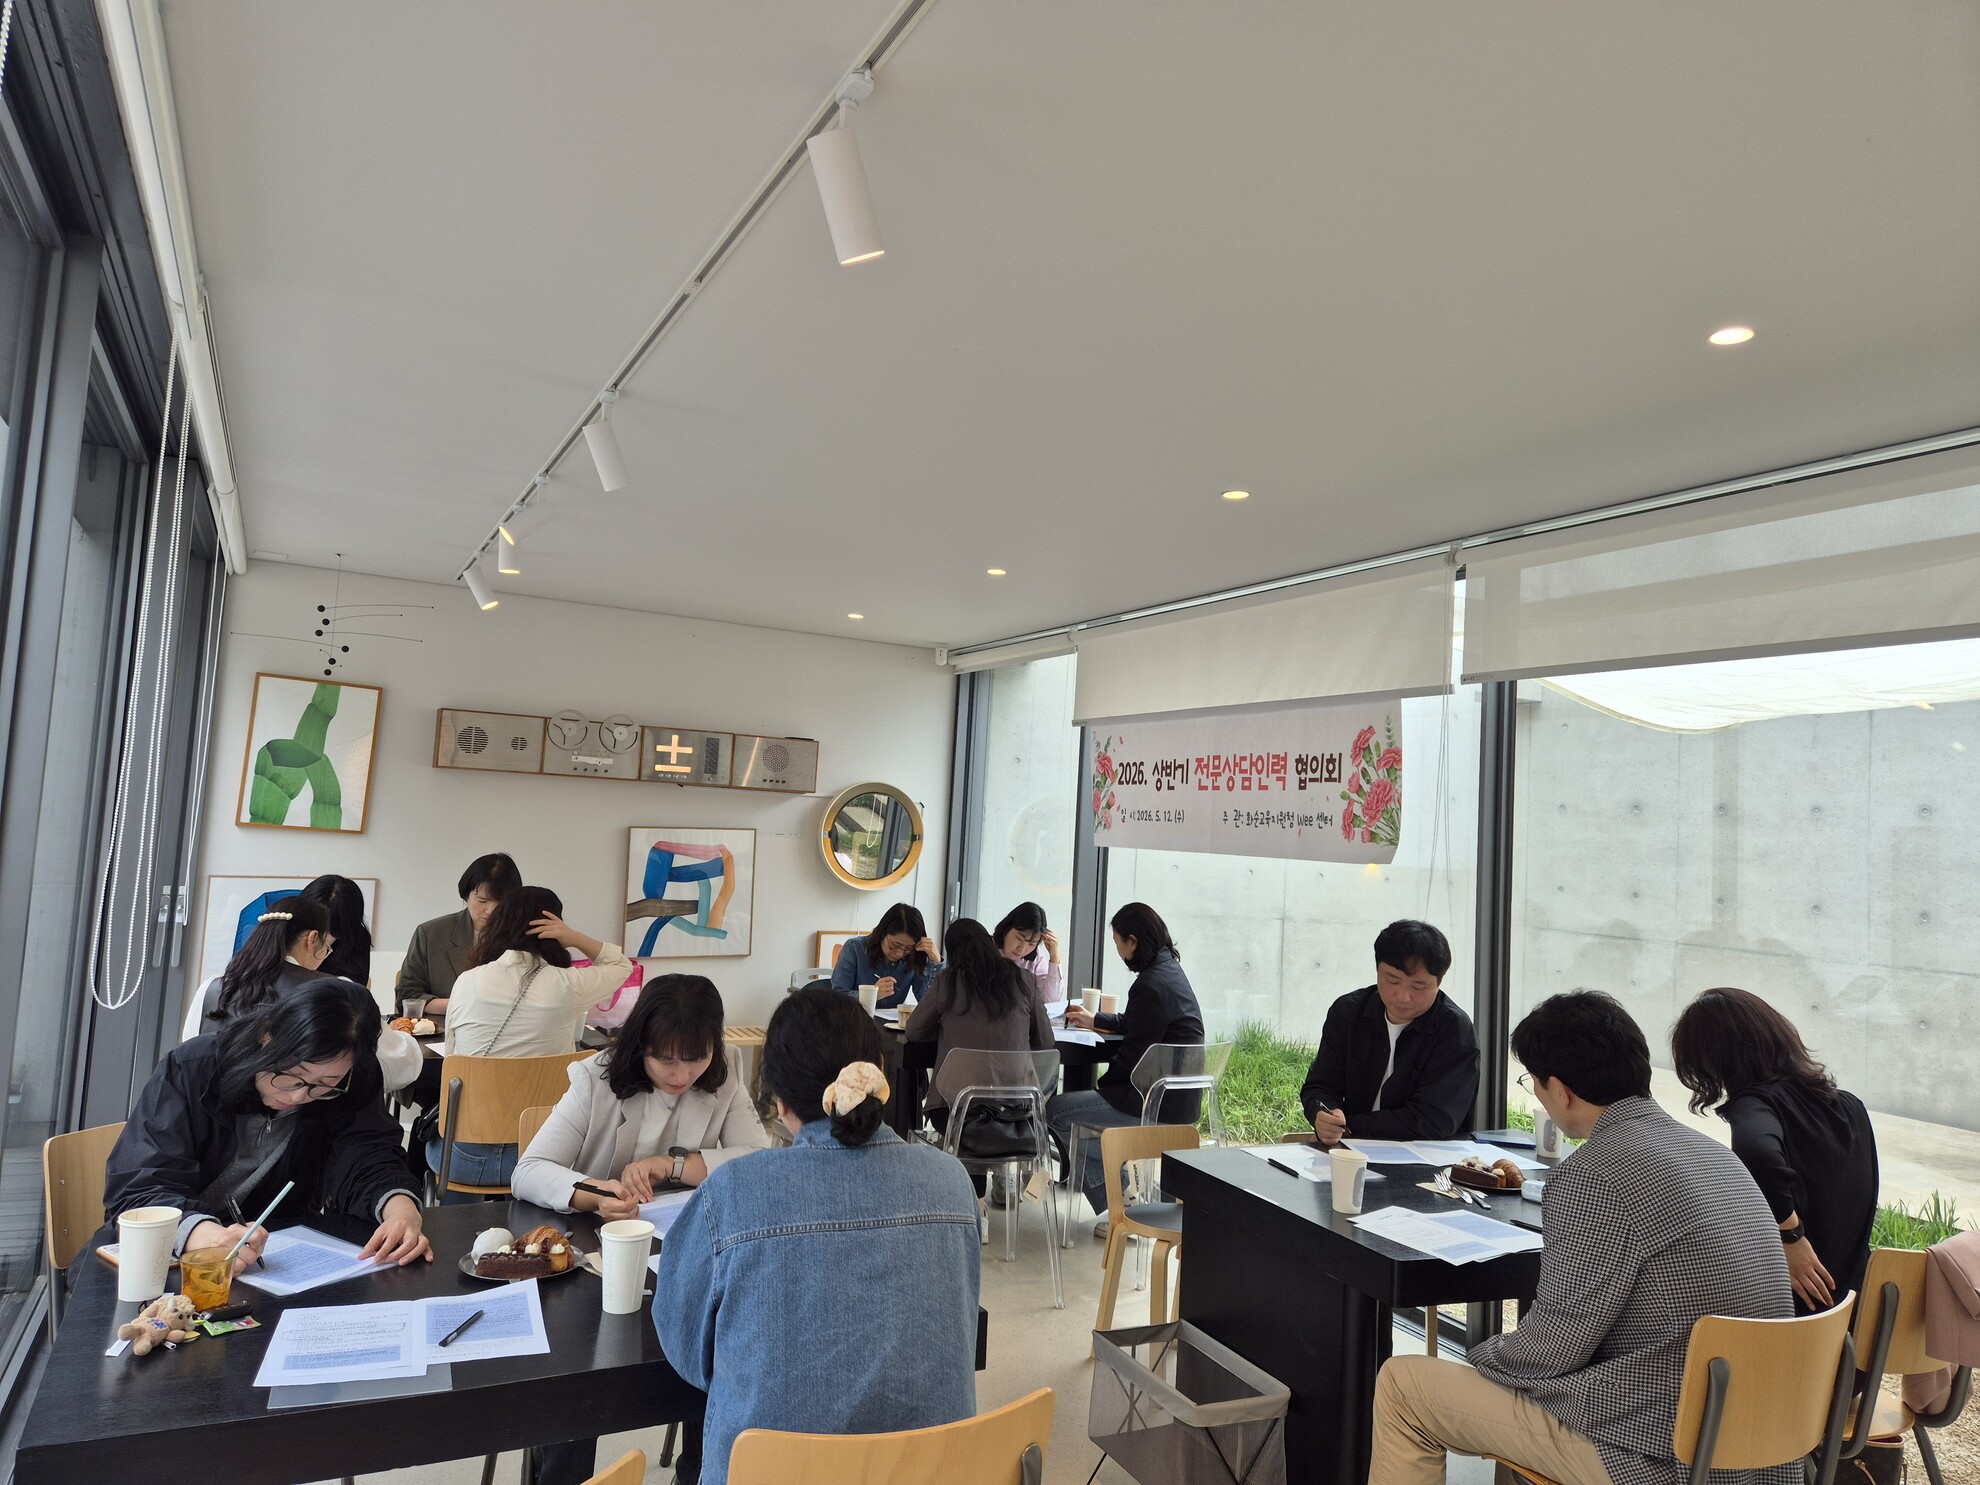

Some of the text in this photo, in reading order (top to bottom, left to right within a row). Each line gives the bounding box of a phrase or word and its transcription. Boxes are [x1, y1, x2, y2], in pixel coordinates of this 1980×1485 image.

[1118, 752, 1343, 792] 2026. 상반기 전문상담인력 협의회
[1246, 810, 1294, 829] 화순교육지원청
[1297, 814, 1313, 827] Wee
[1316, 812, 1333, 829] 센터
